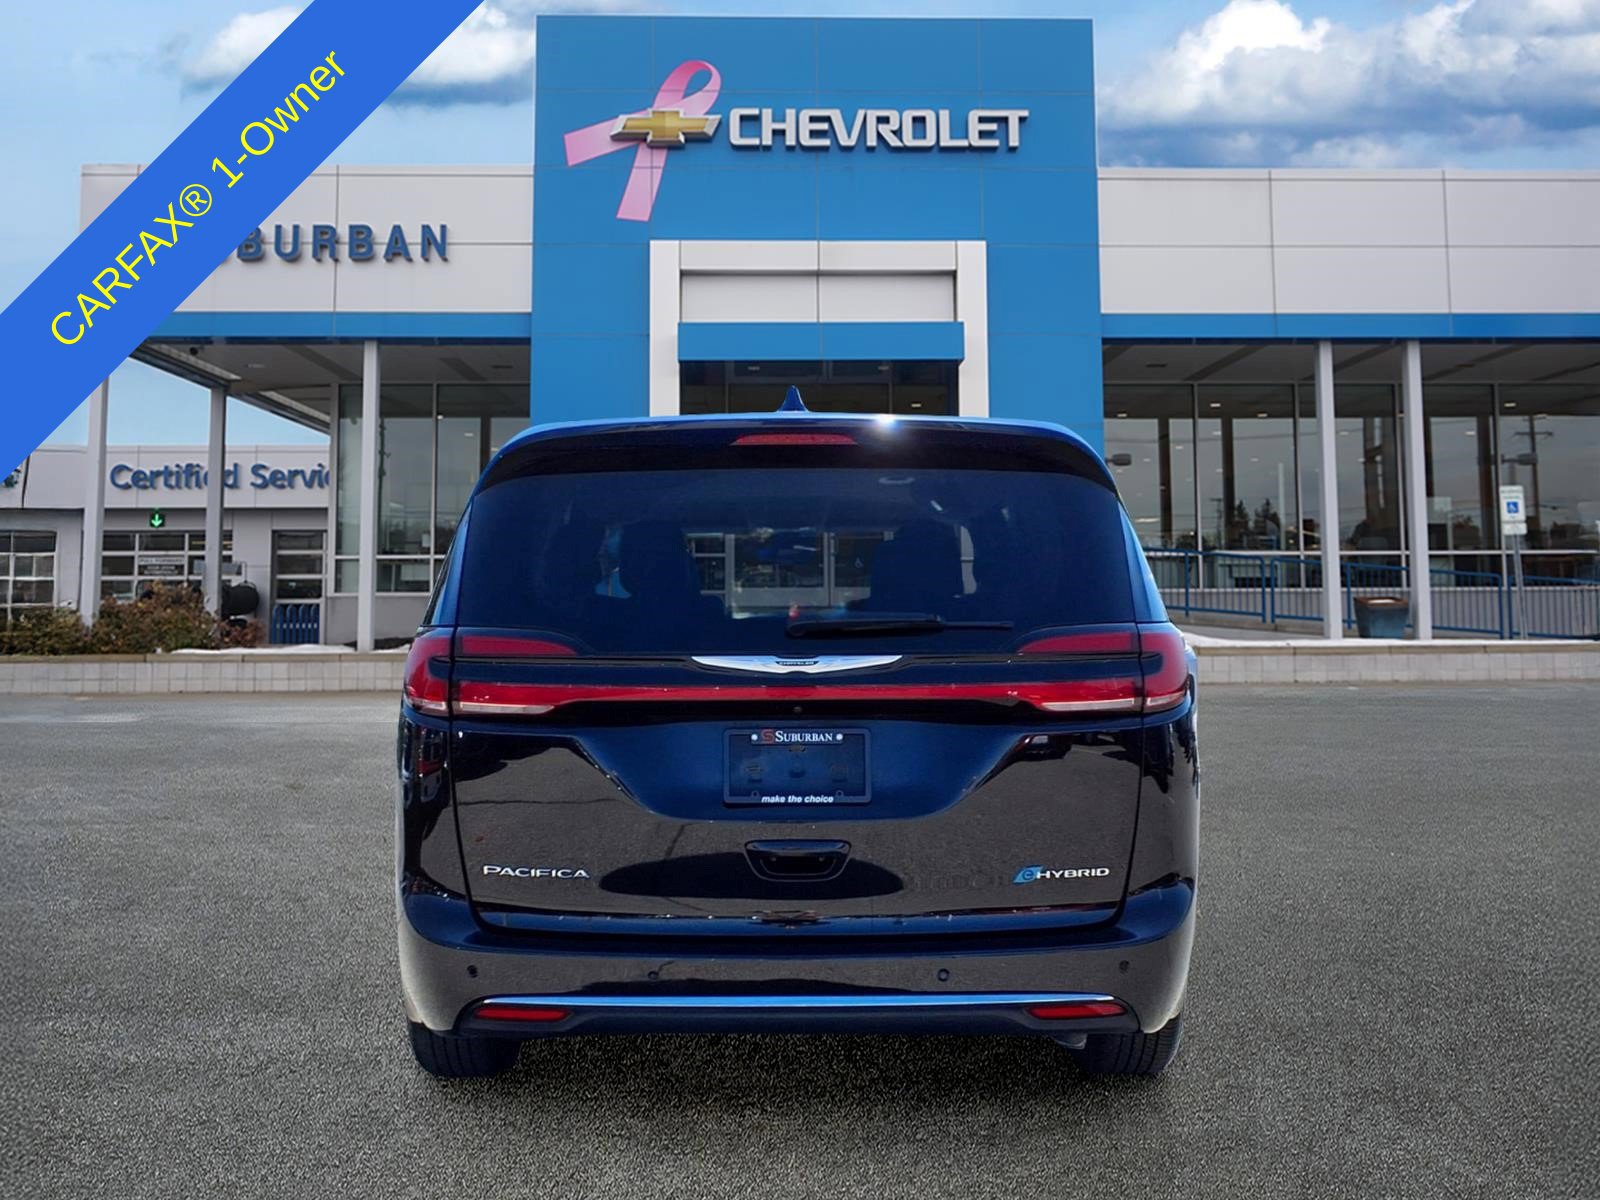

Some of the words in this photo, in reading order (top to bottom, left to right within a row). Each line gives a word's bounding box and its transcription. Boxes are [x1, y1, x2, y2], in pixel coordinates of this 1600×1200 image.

[729, 108, 1029, 150] CHEVROLET
[775, 730, 833, 742] SUBURBAN
[761, 795, 786, 803] make
[788, 795, 802, 803] the
[804, 794, 834, 803] choice
[483, 865, 590, 879] PACIFICA
